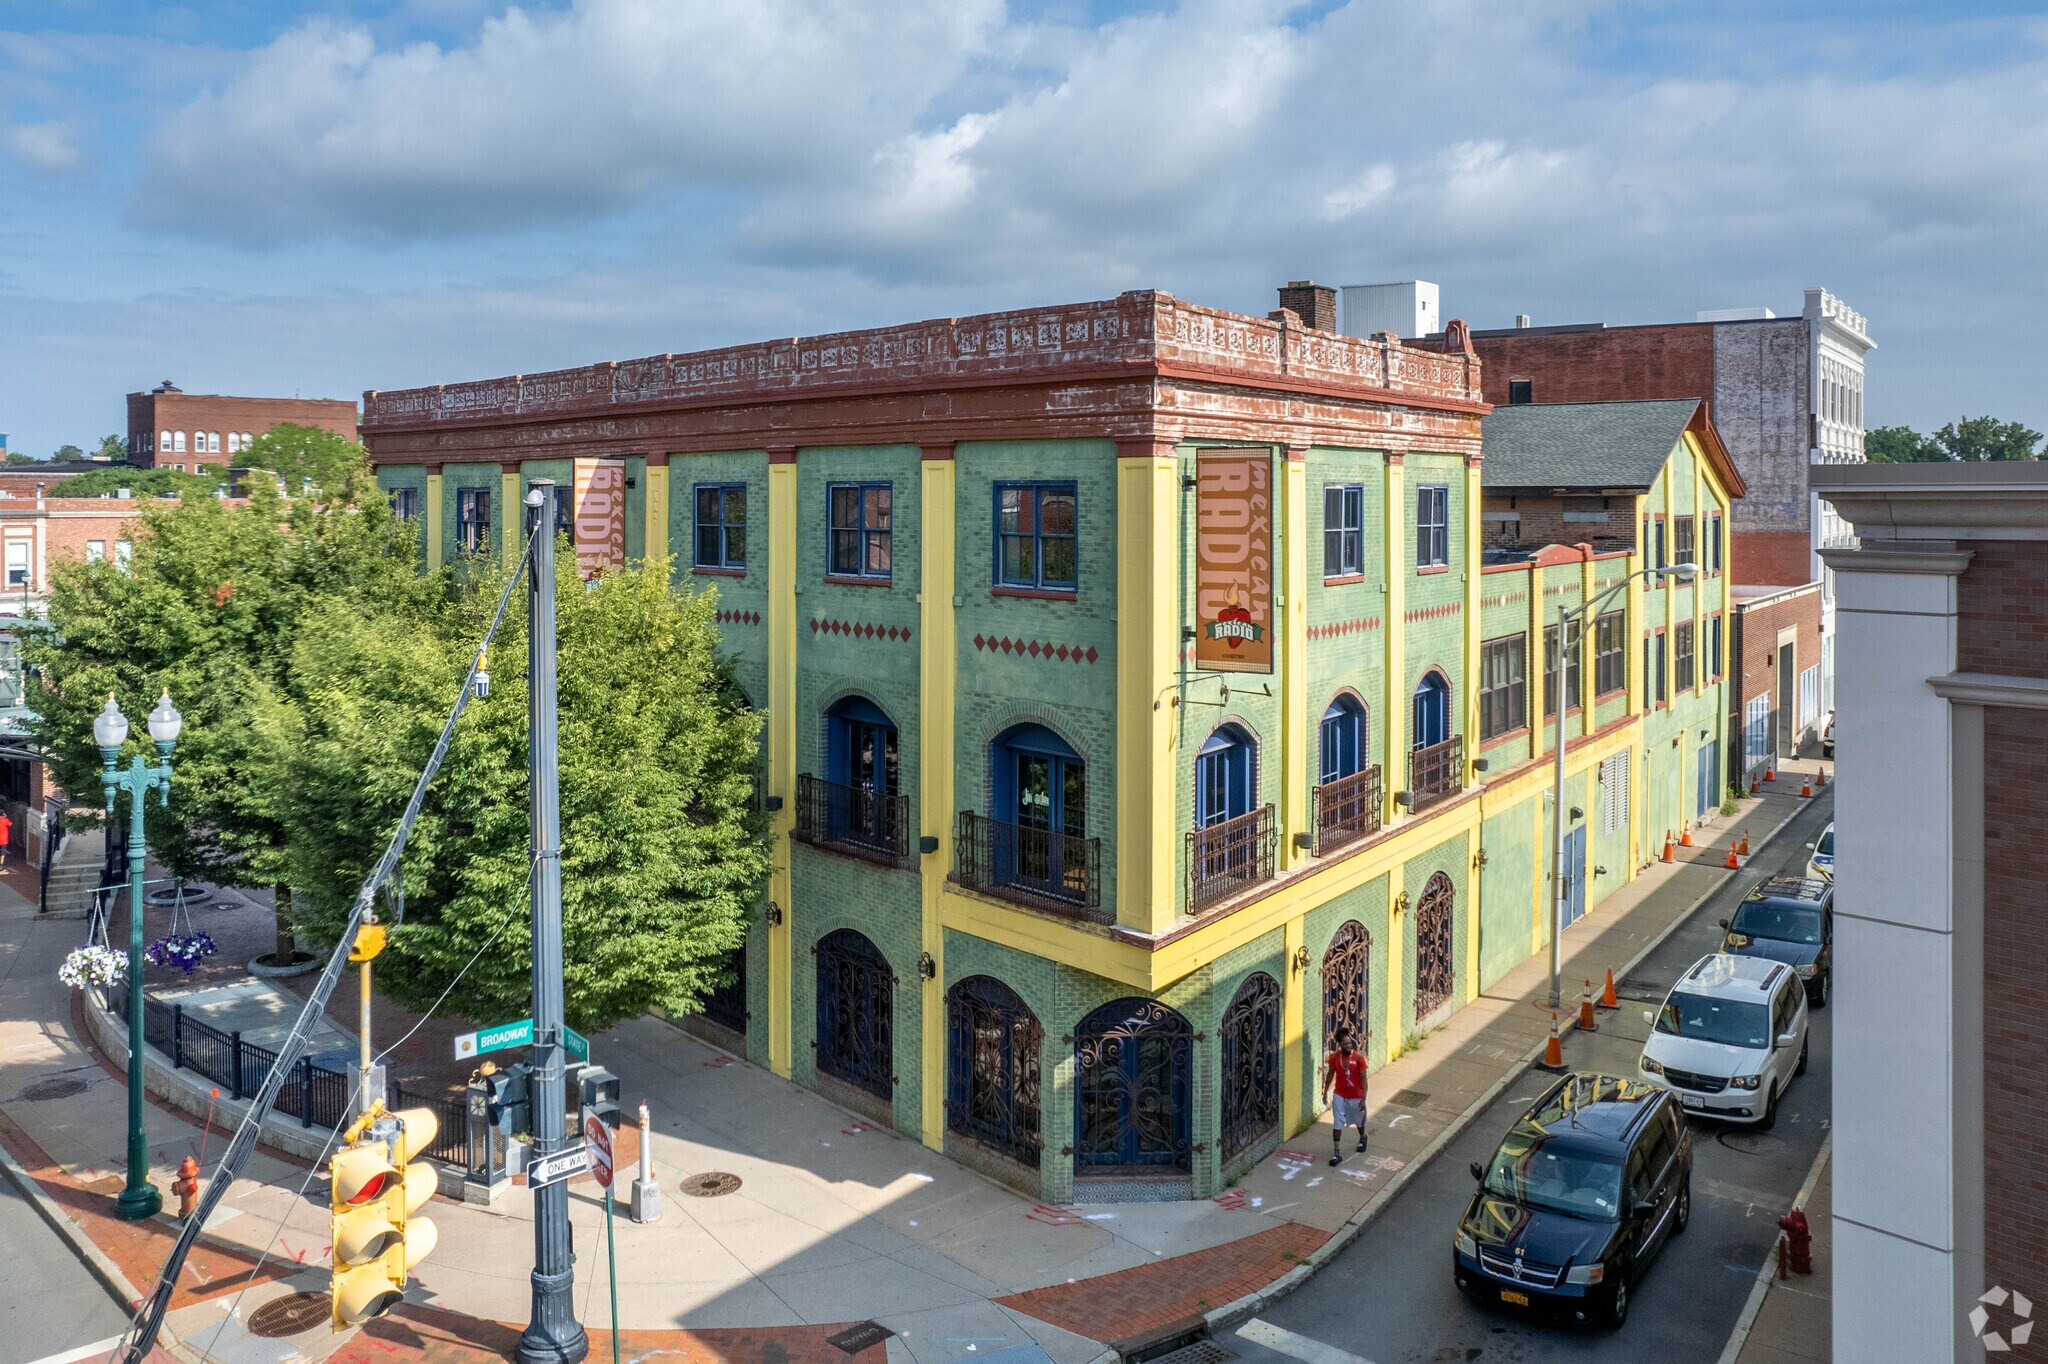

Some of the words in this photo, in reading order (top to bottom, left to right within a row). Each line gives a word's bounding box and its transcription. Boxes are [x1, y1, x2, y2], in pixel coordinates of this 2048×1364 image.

[611, 467, 624, 572] mexica
[1199, 460, 1251, 620] RADIO
[1214, 624, 1254, 641] RADIO
[481, 1025, 529, 1048] BROADWAY
[588, 1123, 596, 1138] DO
[597, 1132, 609, 1151] NOT
[548, 1160, 566, 1175] ONE
[569, 1154, 587, 1168] WAY
